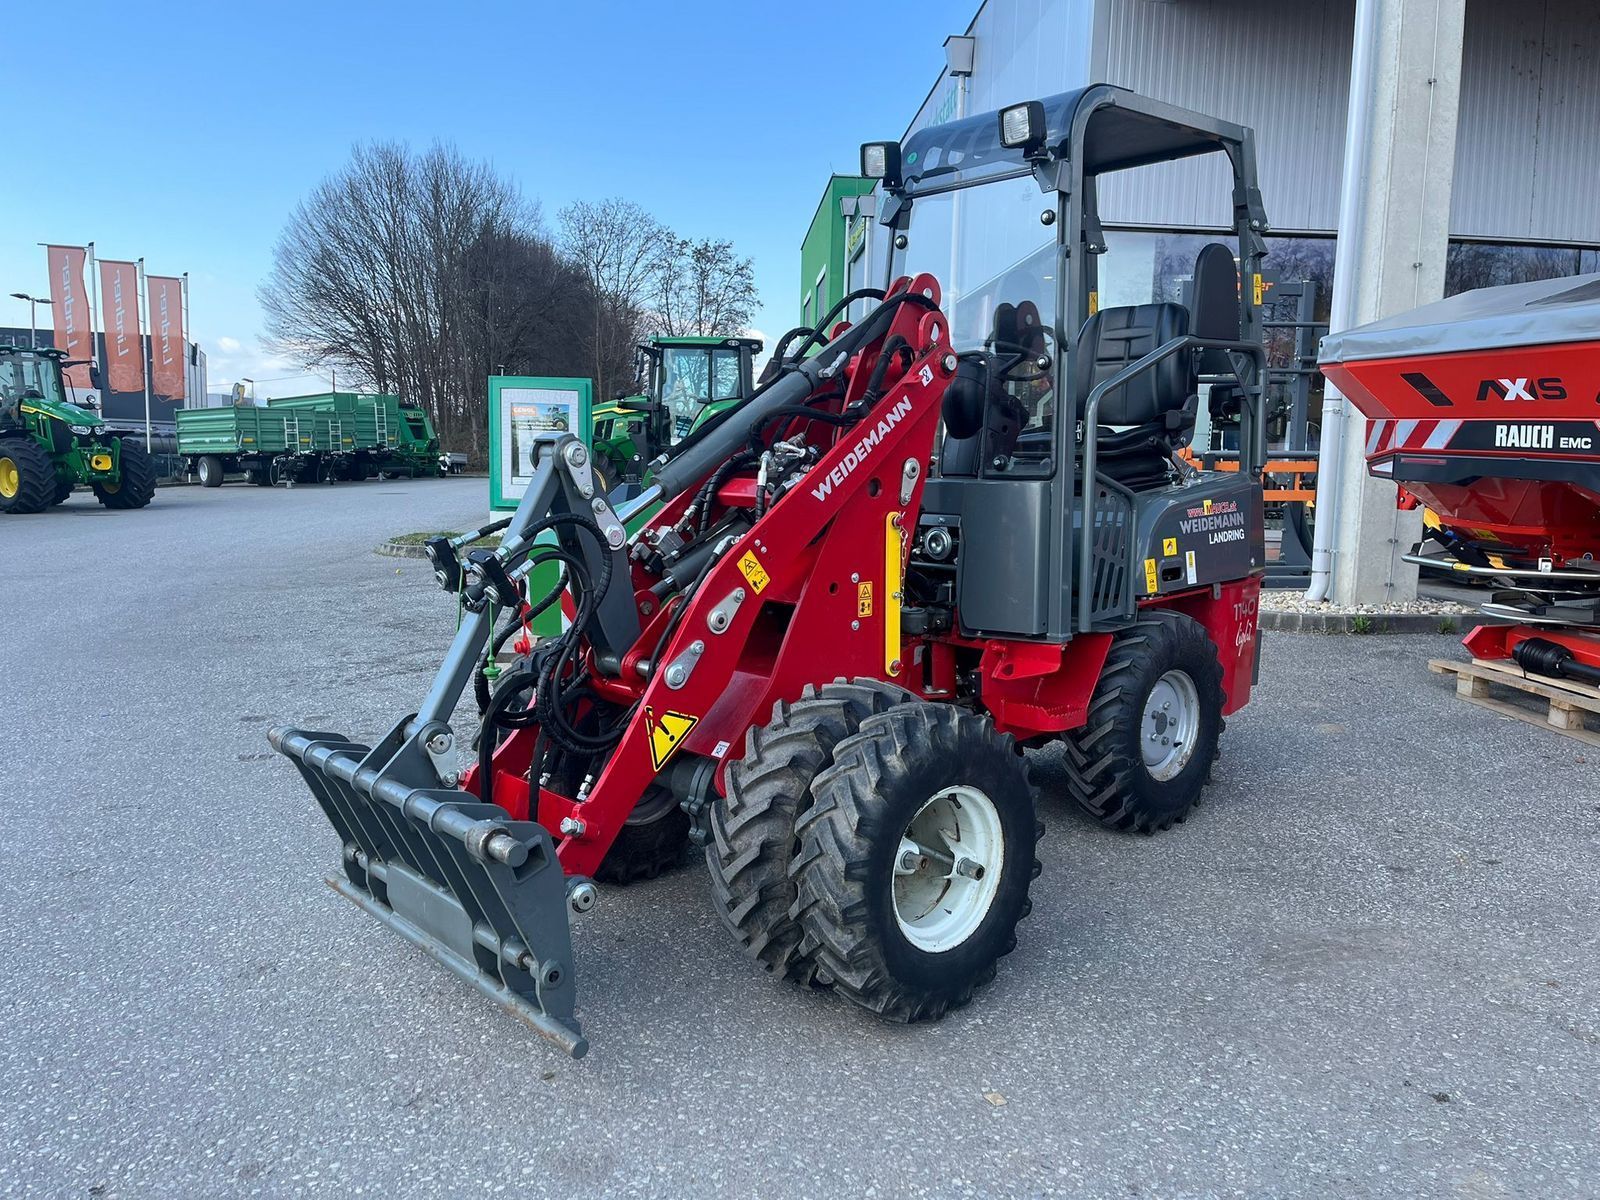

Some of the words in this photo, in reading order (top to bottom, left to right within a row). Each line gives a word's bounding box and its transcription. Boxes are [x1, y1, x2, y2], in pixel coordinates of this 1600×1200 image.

[1495, 424, 1554, 449] RAUCH
[1559, 437, 1592, 449] EMC
[811, 395, 913, 502] WEIDEMANN
[1180, 512, 1244, 534] WEIDEMANN
[1209, 529, 1245, 544] LANDRING
[1233, 598, 1255, 621] 1140
